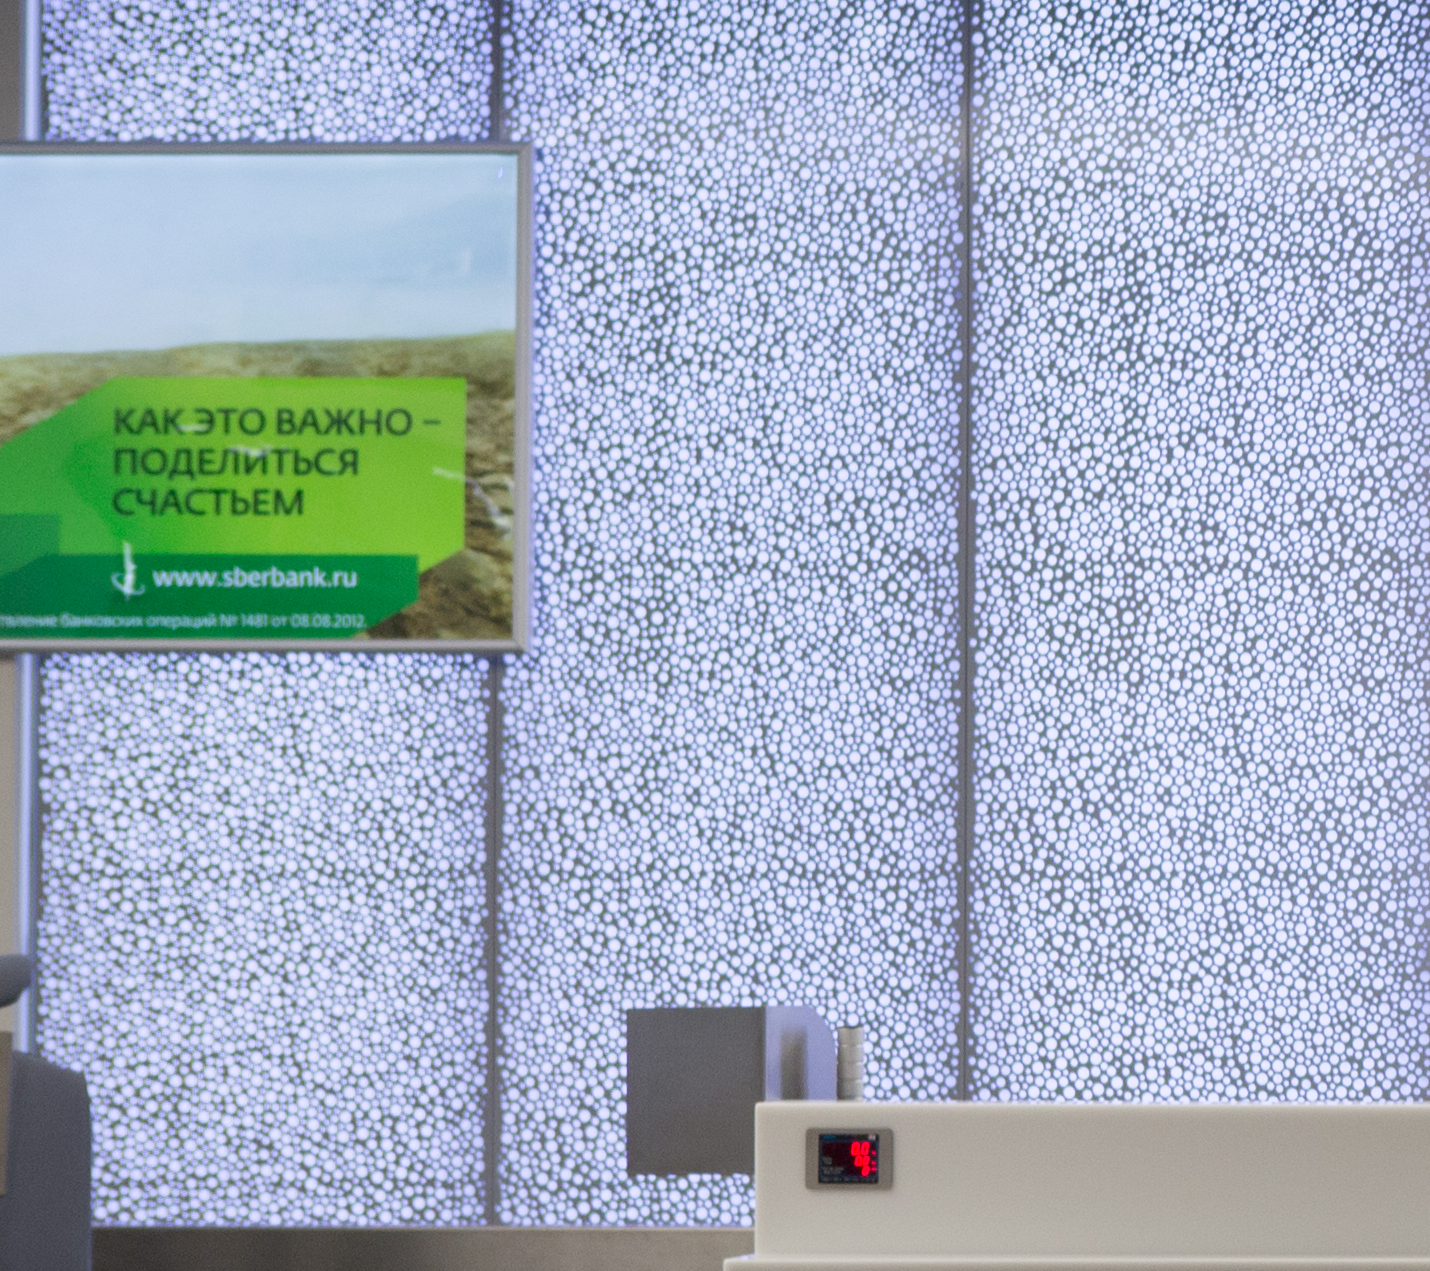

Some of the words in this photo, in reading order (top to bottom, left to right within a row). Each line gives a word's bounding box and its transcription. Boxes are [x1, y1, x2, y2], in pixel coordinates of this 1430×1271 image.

[113, 408, 181, 436] КАК
[186, 408, 266, 436] ЭТО
[276, 408, 413, 436] ВАЖНО
[113, 448, 359, 480] ПОДЕЛИТЬСЯ
[112, 488, 304, 516] СЧАСТЬЕМ
[152, 567, 358, 588] www.sberbank.ru
